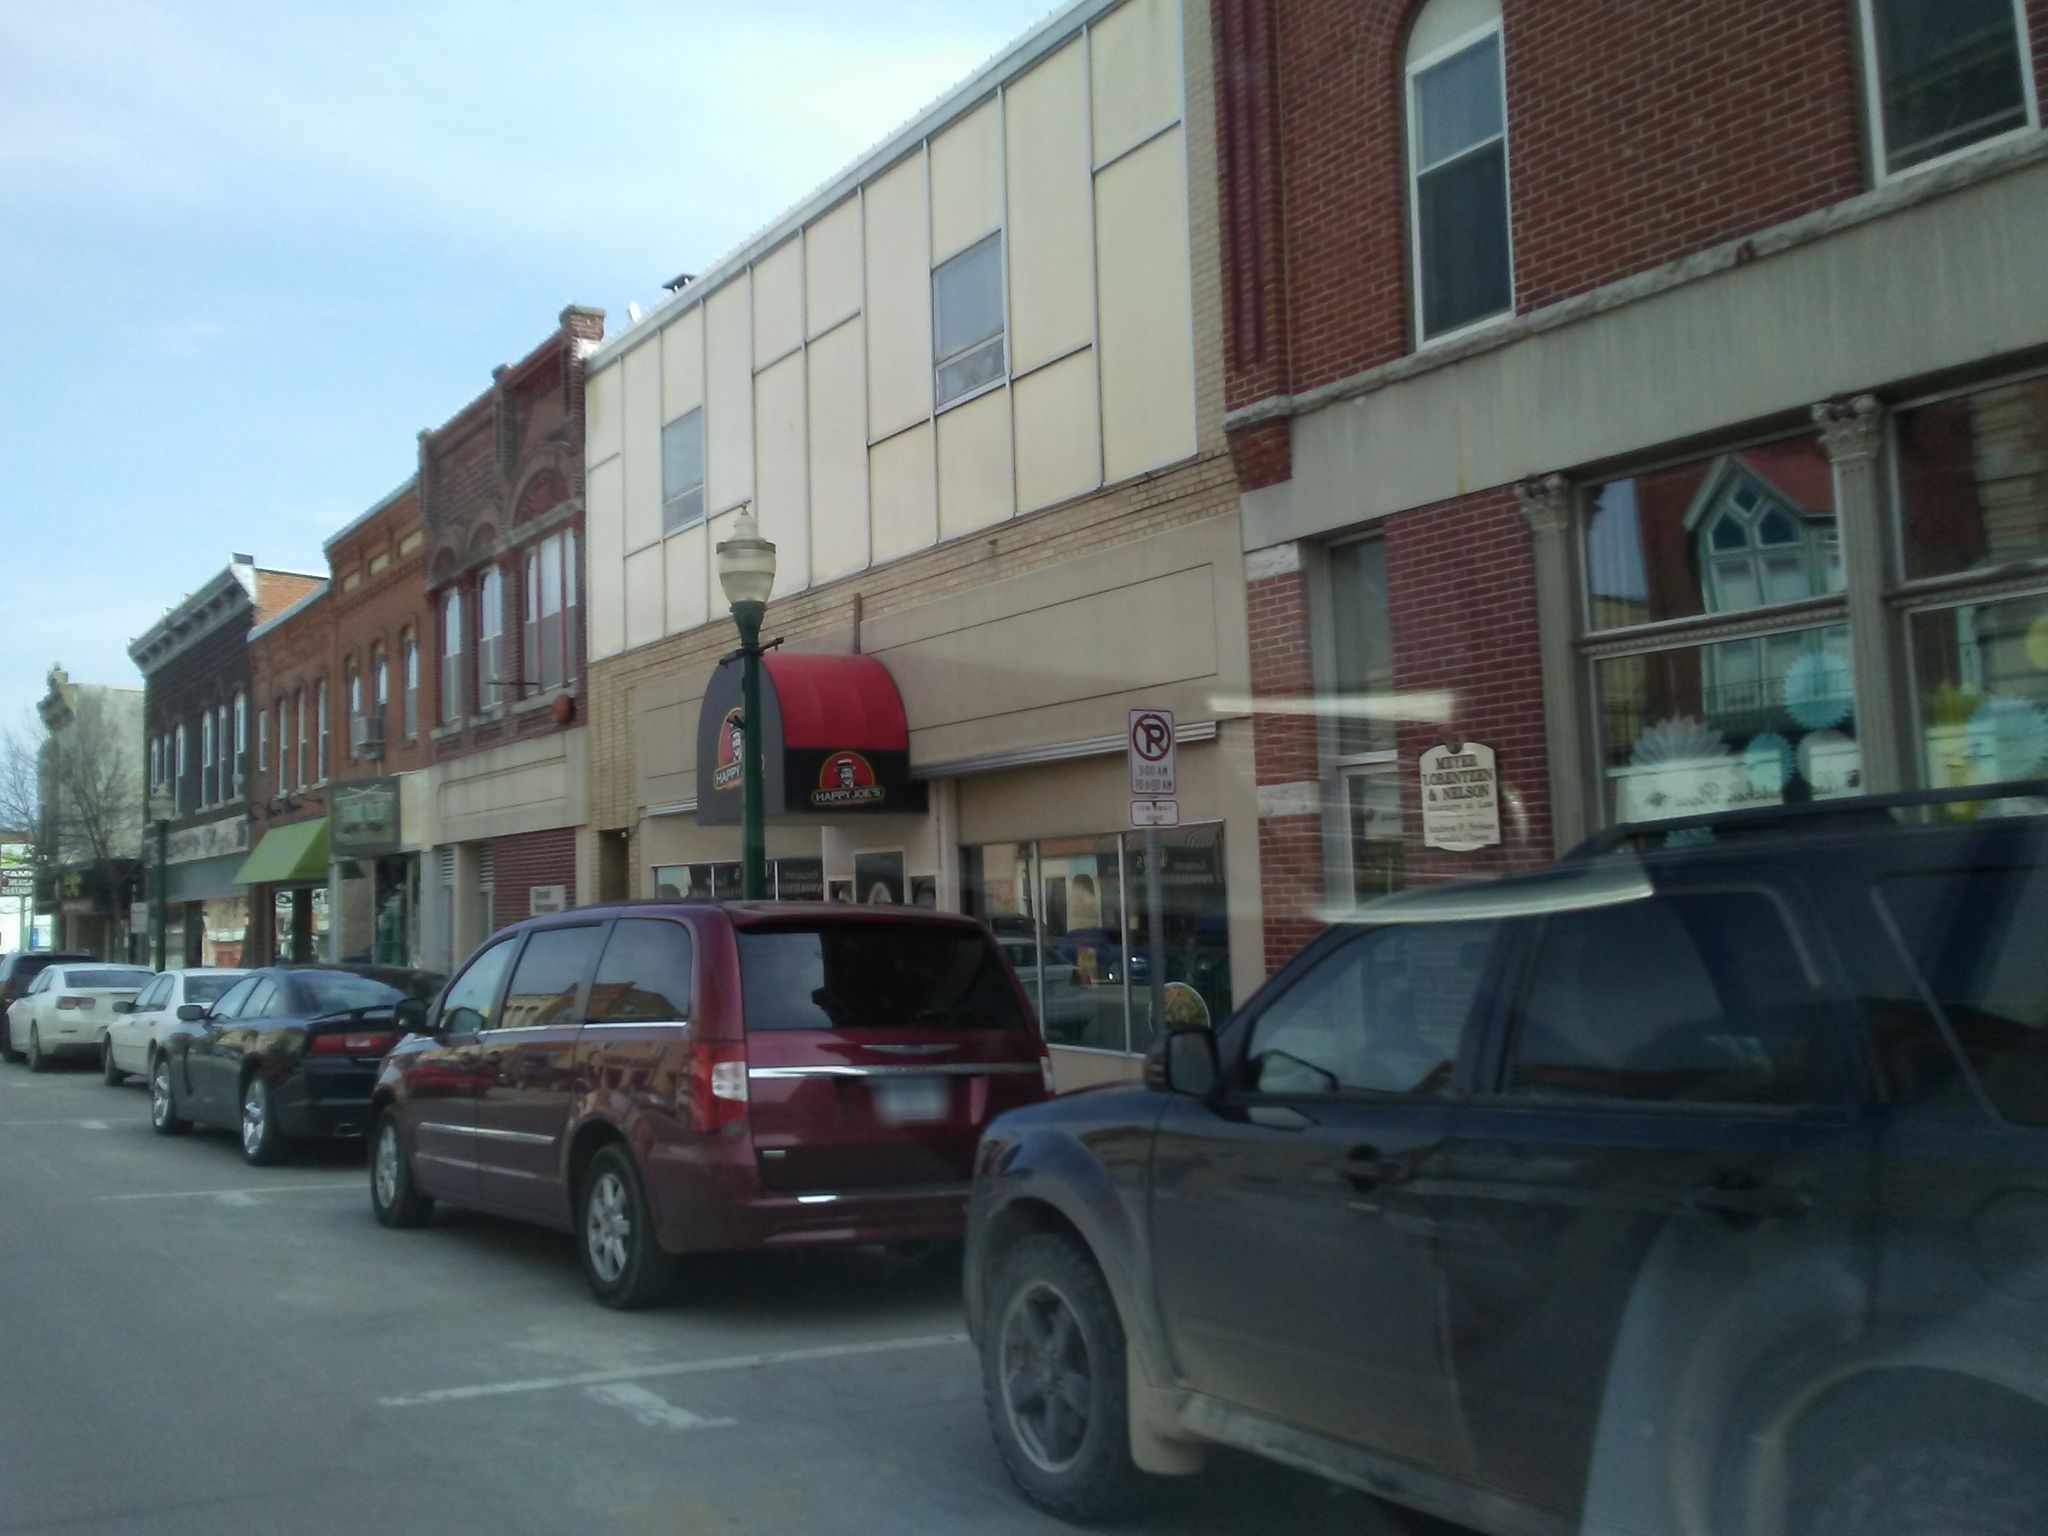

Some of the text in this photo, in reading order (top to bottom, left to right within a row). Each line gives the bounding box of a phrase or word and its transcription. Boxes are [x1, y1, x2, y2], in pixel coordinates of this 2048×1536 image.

[1435, 754, 1477, 770] MEYER
[716, 764, 741, 785] HAPPY
[1422, 768, 1494, 786] LORENTZEN
[815, 787, 881, 802] HAPPY JOE'S
[1428, 784, 1489, 801] & NELSON
